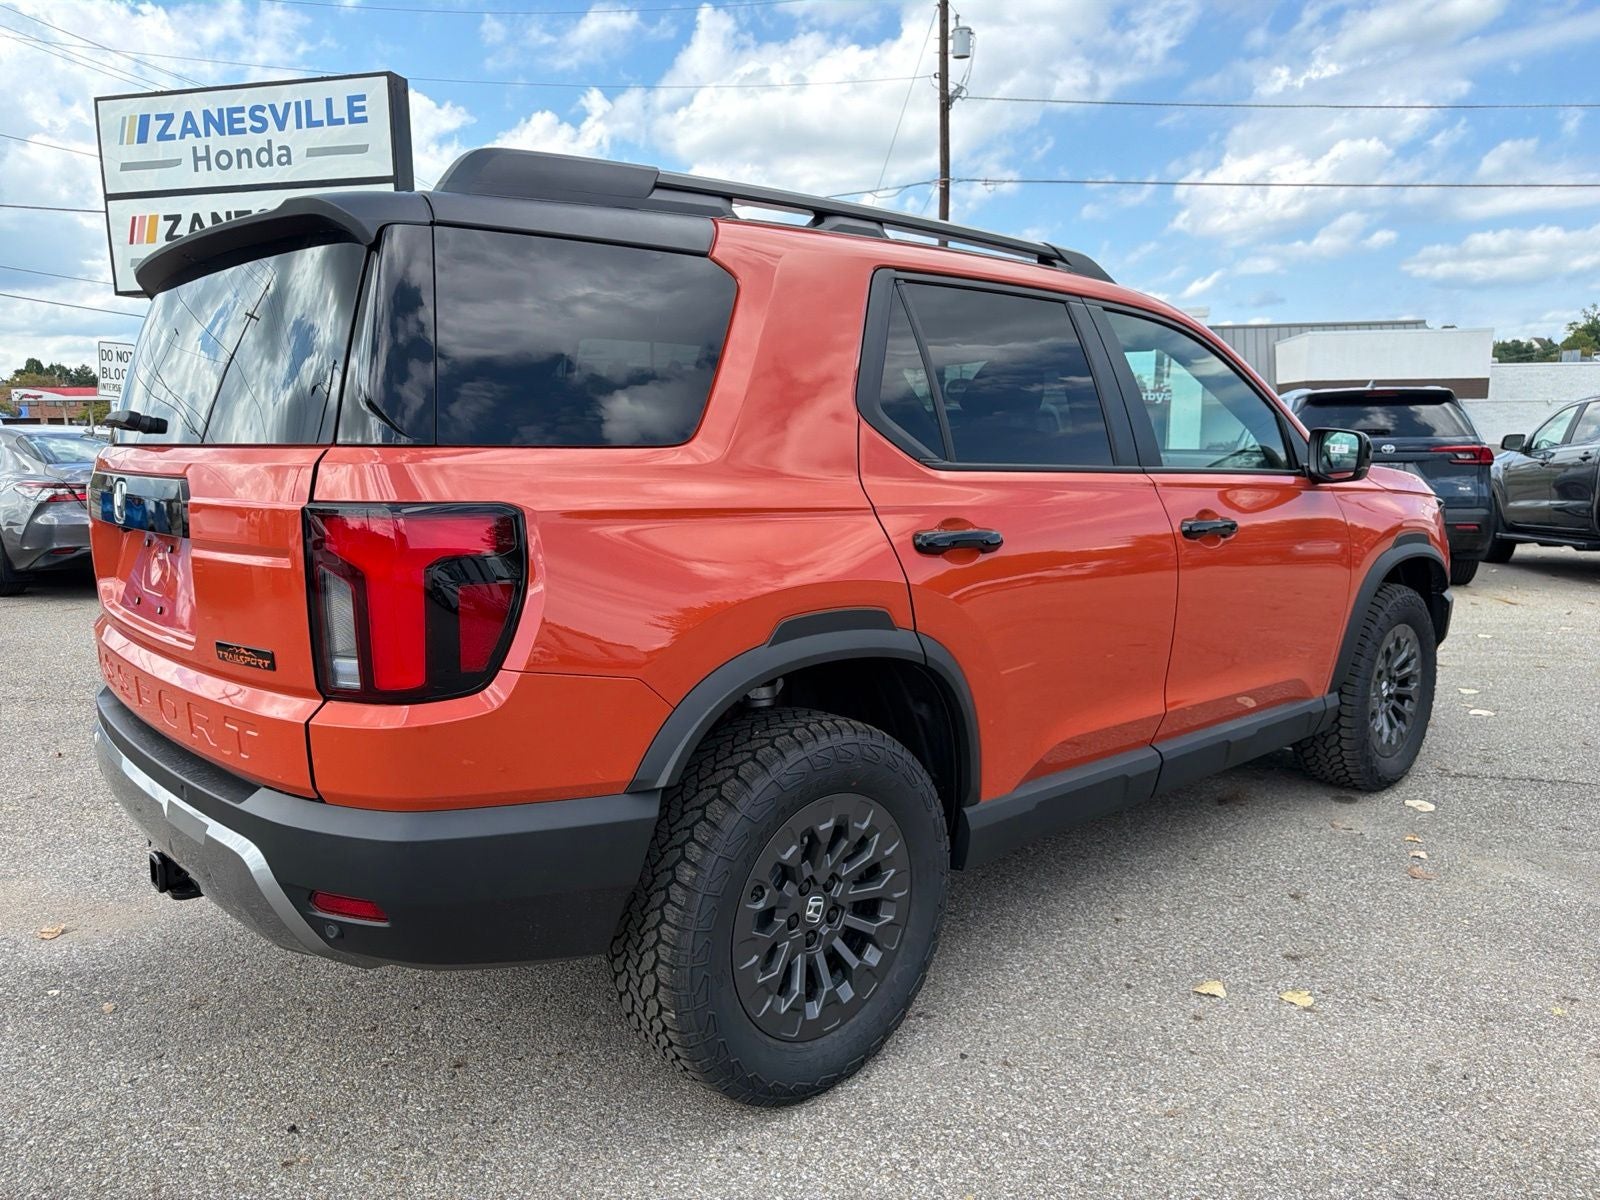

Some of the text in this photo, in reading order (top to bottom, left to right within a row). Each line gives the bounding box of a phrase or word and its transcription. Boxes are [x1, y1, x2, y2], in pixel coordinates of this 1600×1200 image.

[155, 93, 369, 142] ZANESVILLE
[192, 139, 293, 173] Honda
[101, 349, 113, 361] DO
[101, 367, 127, 380] BLOC
[217, 650, 271, 669] TRAILSPORT
